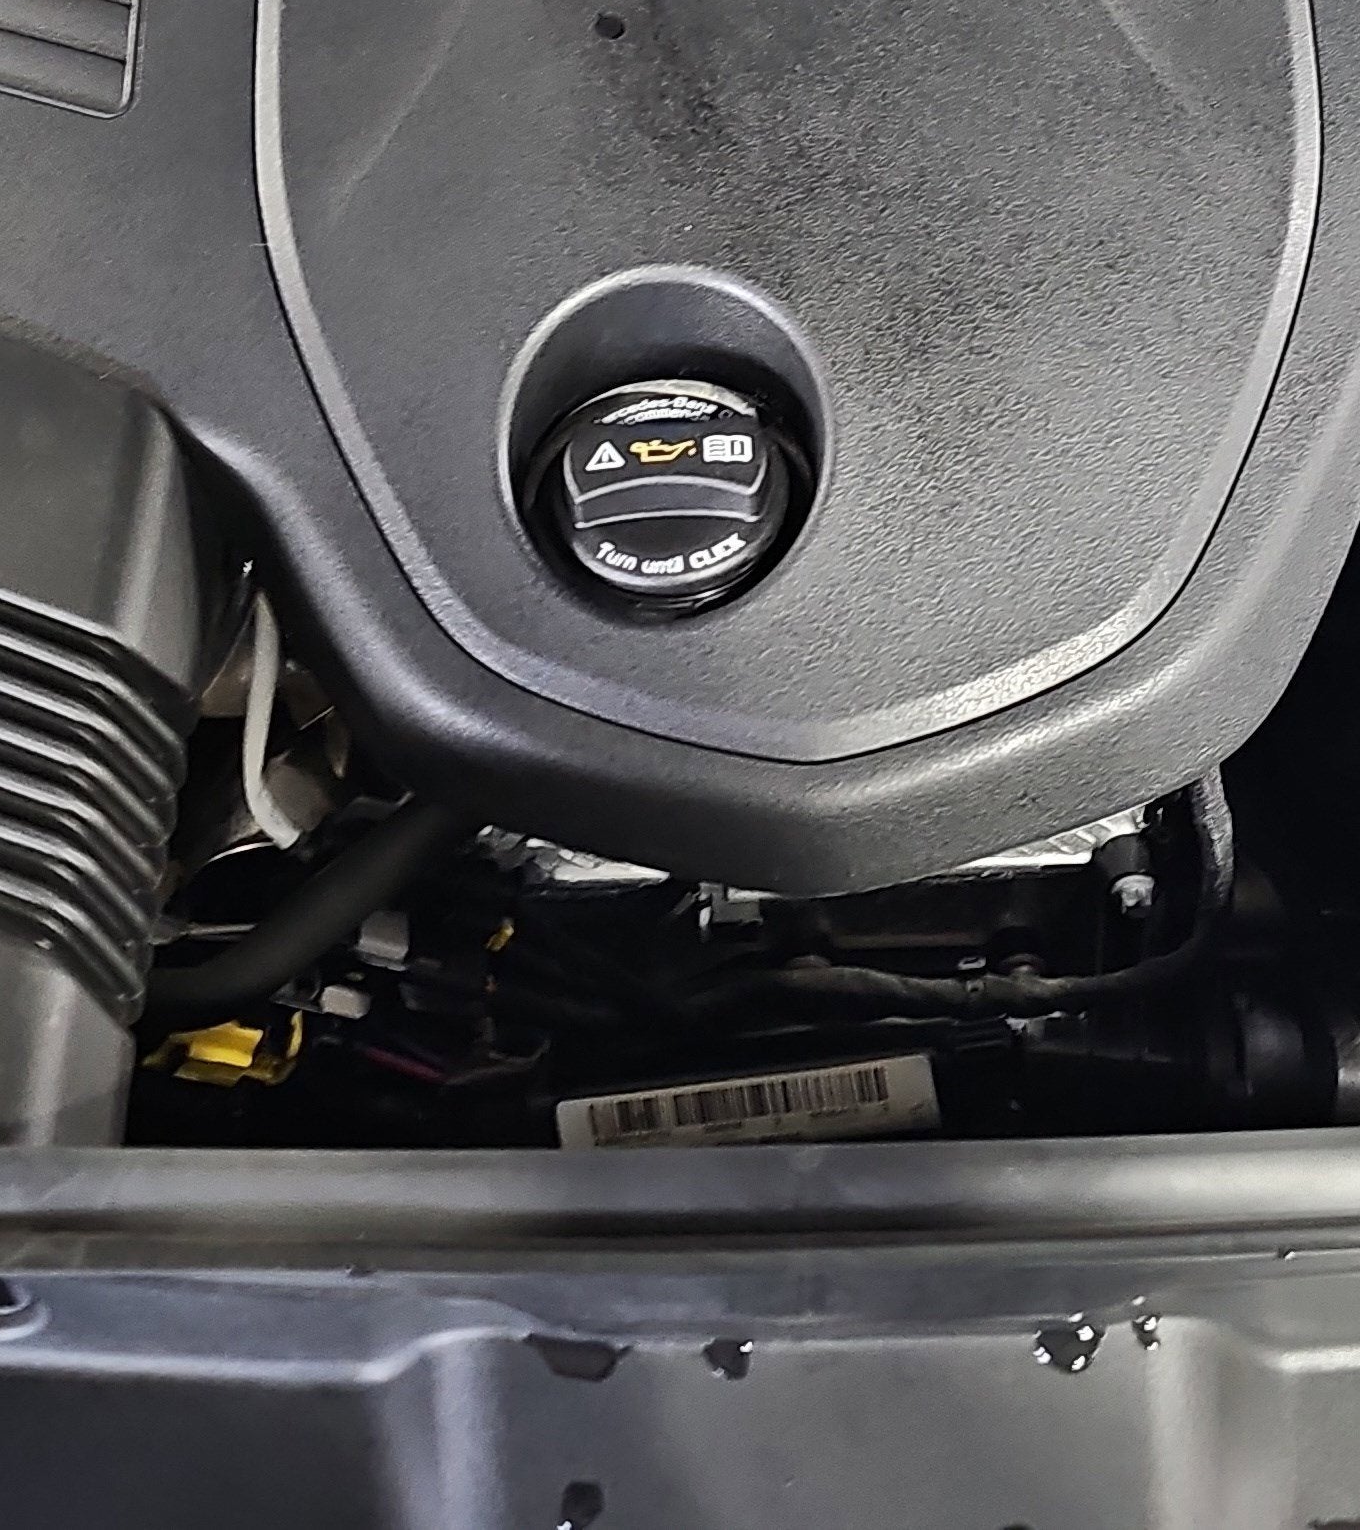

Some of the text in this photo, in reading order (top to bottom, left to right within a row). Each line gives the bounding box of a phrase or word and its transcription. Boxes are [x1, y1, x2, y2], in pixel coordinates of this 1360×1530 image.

[596, 533, 748, 574] Turn until CLICK
